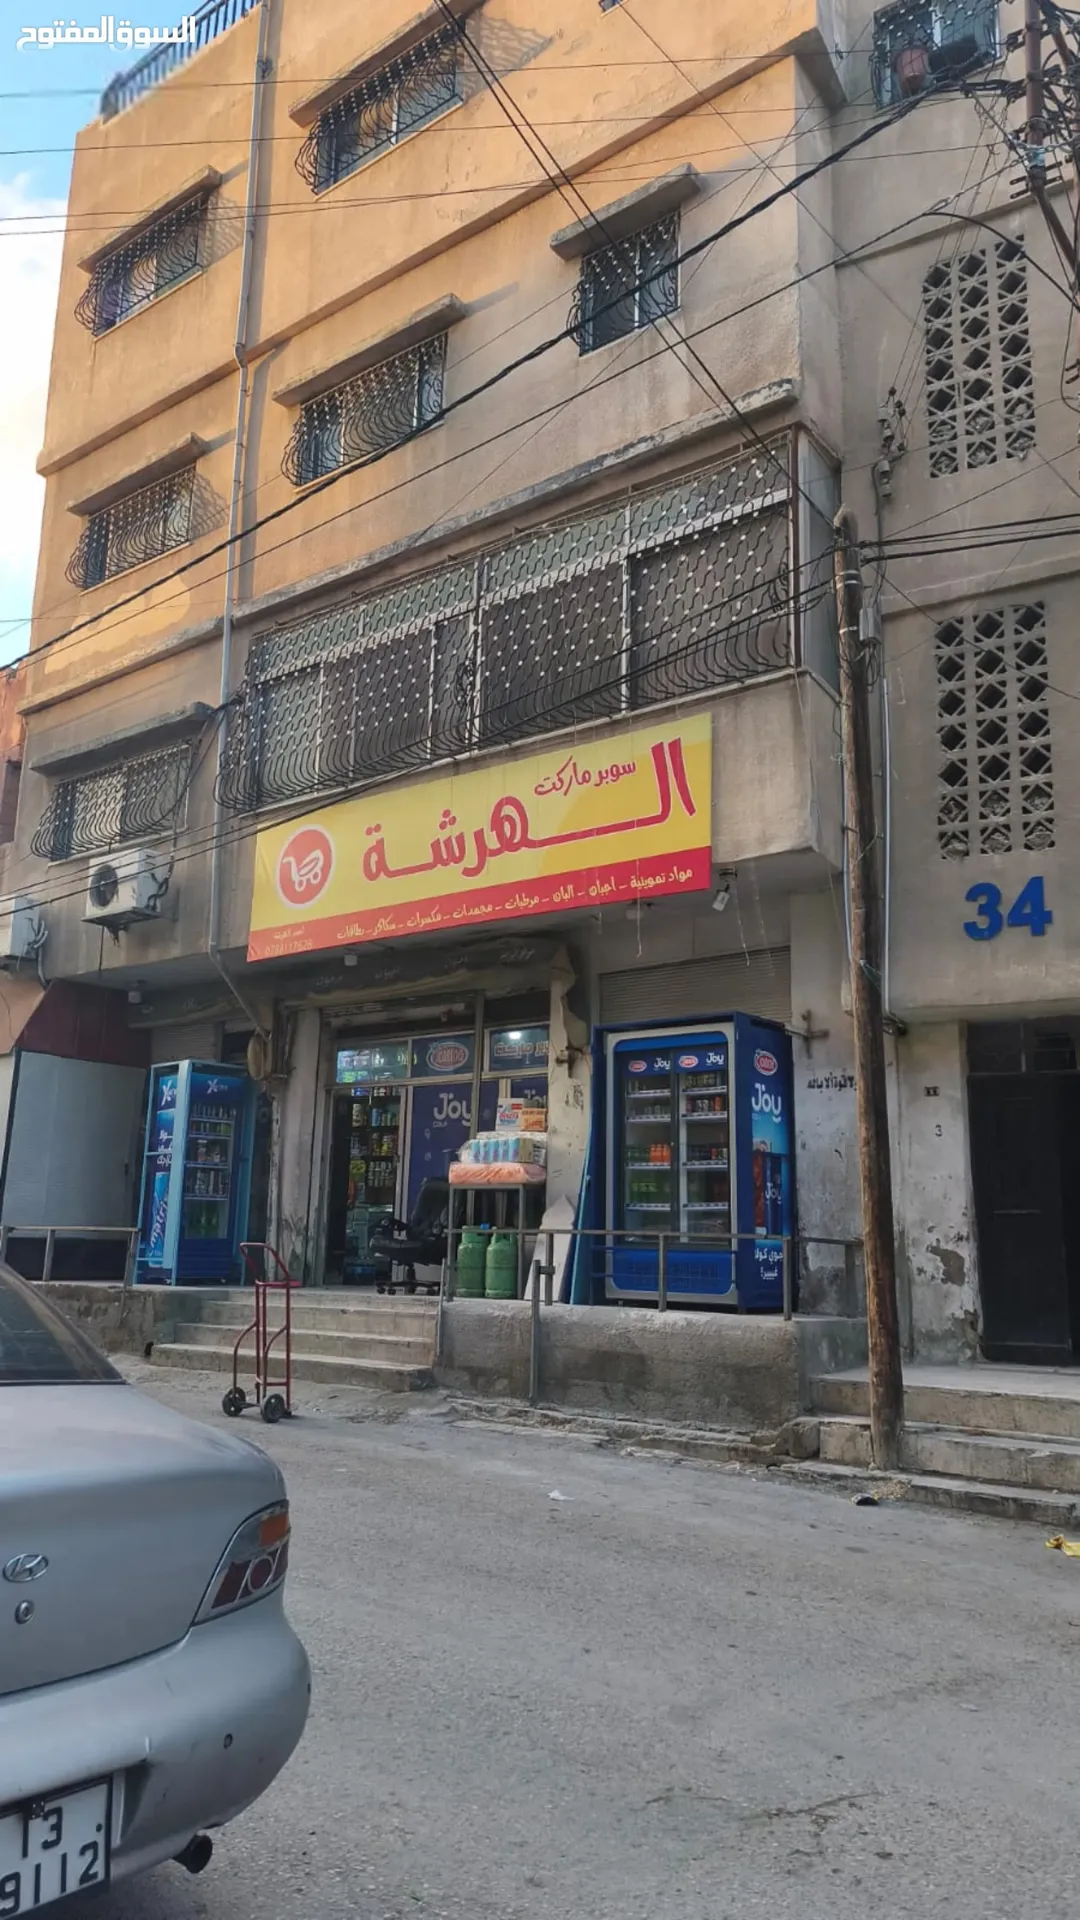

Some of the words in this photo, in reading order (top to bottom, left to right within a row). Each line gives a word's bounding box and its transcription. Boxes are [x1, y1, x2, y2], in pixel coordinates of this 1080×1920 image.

[534, 755, 591, 796] ماركت
[594, 761, 636, 787] سوبر
[362, 737, 696, 883] الهرشة
[630, 874, 666, 890] تموينية
[668, 865, 693, 882] مواد
[504, 892, 540, 910] مرطبات
[552, 884, 574, 903] البان
[406, 904, 442, 928] مكسرات
[452, 903, 493, 919] مجمدات
[963, 875, 1053, 941] 34
[751, 1082, 782, 1124] Joy
[21, 1805, 63, 1859] 13
